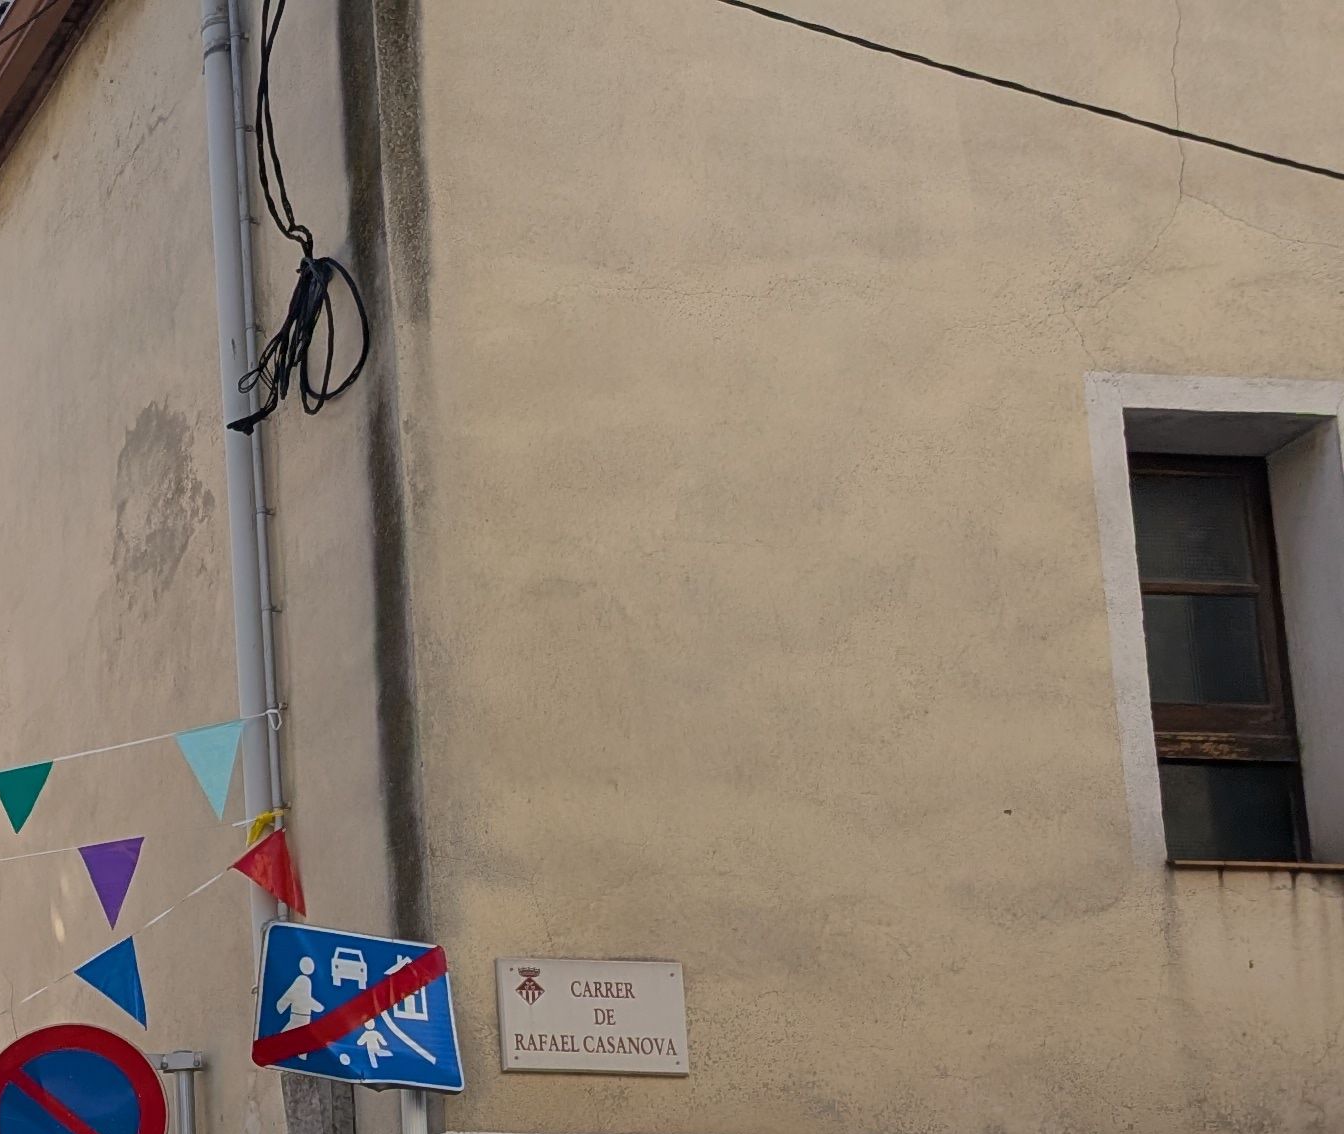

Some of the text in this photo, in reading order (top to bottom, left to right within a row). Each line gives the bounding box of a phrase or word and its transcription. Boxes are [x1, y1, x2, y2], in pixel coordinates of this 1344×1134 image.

[570, 980, 636, 999] CARRER
[593, 1008, 616, 1026] DE
[514, 1033, 678, 1056] RAFAEL CASANOVA
